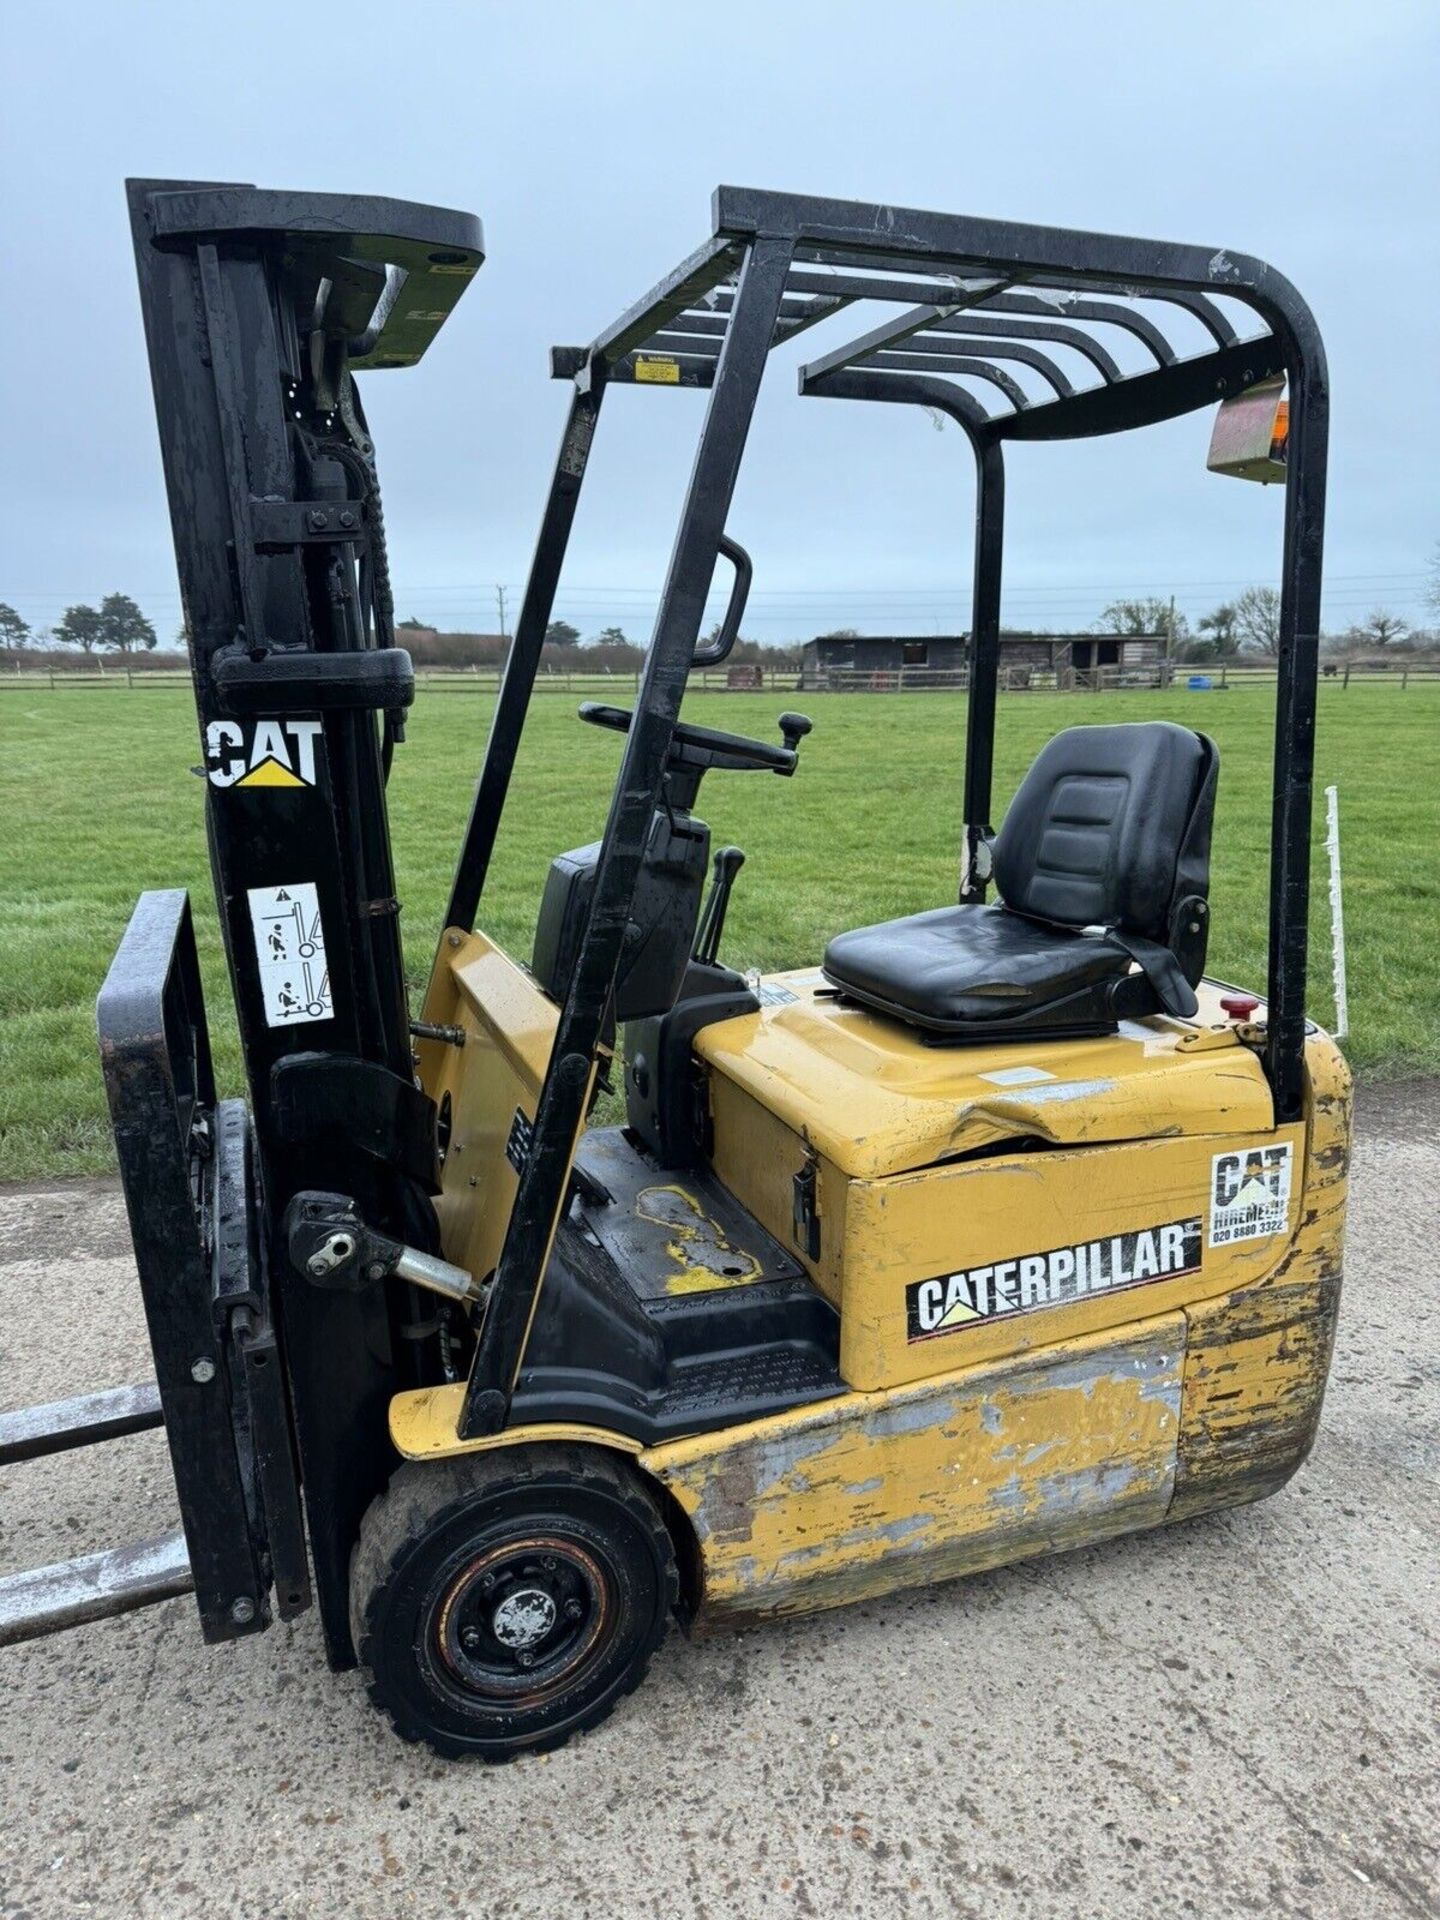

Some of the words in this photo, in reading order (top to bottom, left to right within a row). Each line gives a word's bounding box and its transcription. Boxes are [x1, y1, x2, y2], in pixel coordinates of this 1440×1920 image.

[206, 720, 323, 788] CAT
[1215, 1146, 1288, 1207] CAT
[1213, 1230, 1231, 1243] 020
[1259, 1220, 1283, 1233] 3322
[917, 1224, 1186, 1331] CATERPILLAR
